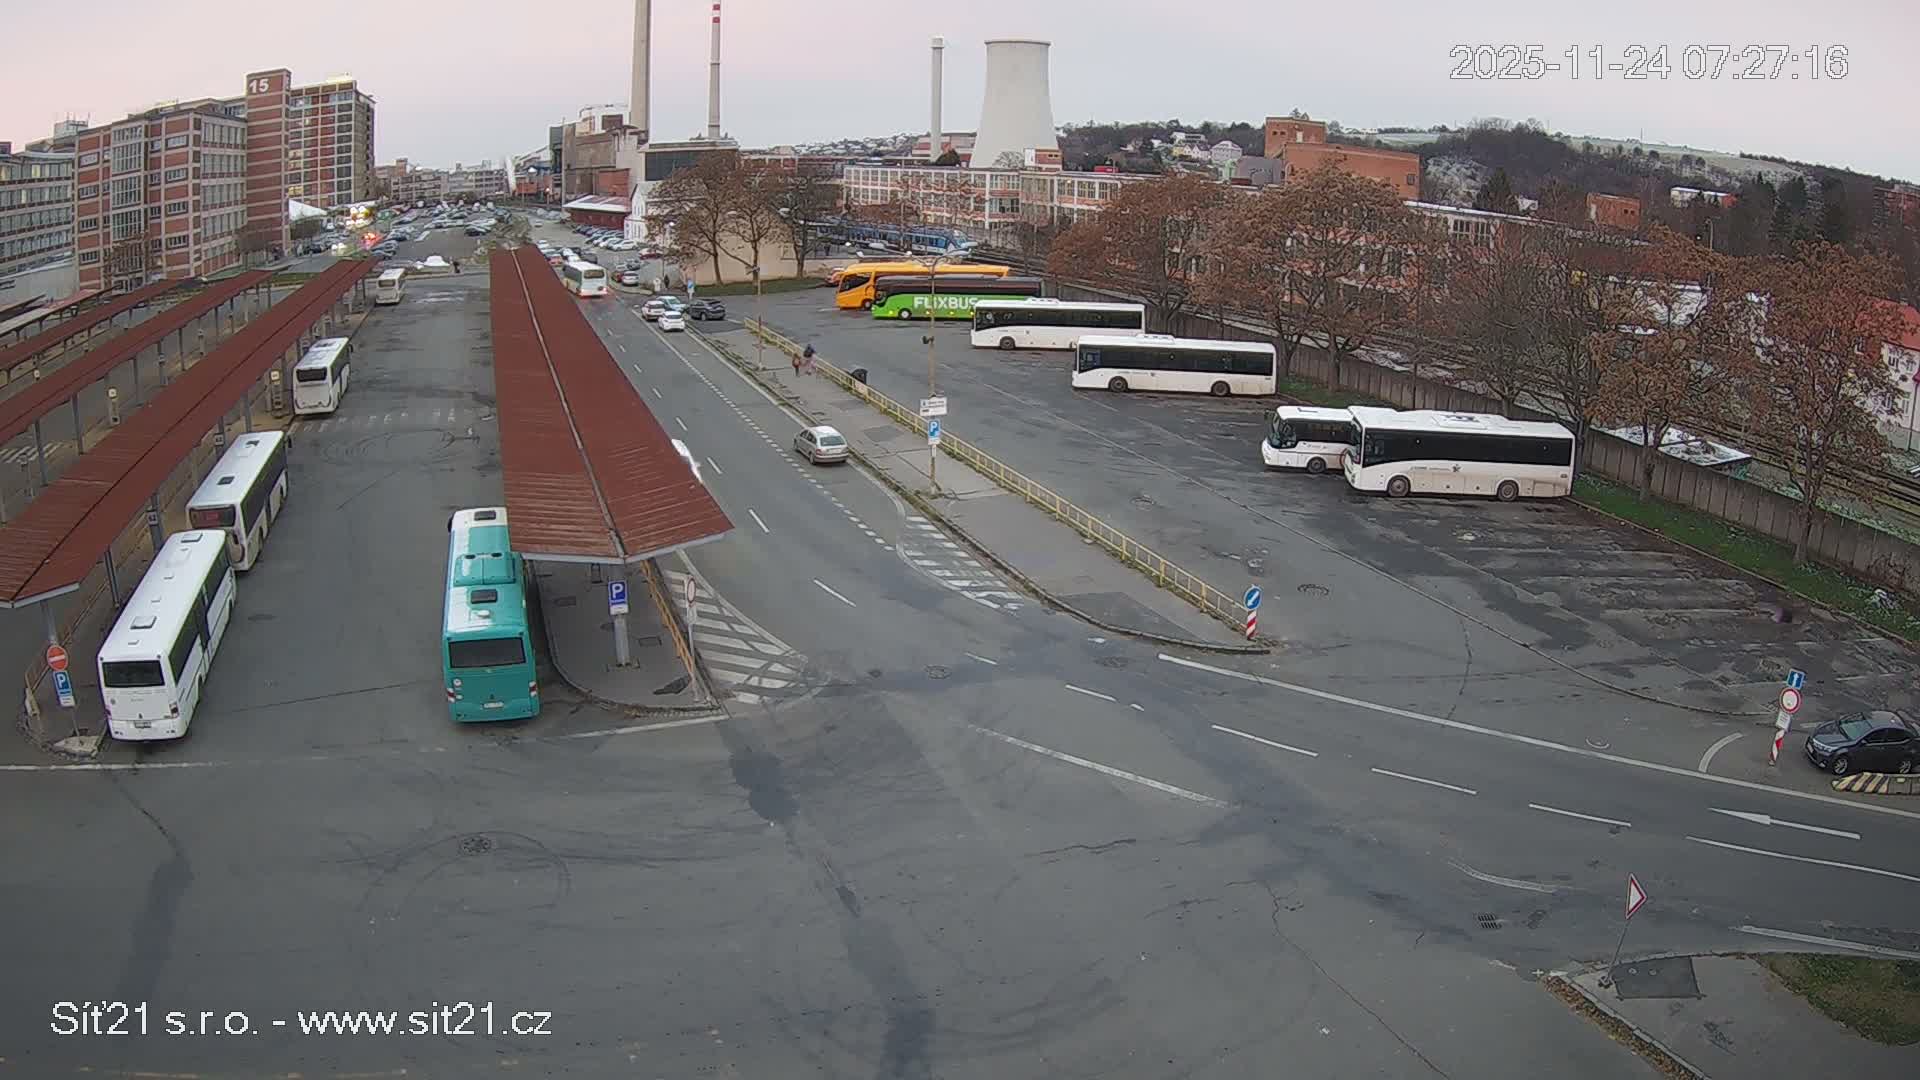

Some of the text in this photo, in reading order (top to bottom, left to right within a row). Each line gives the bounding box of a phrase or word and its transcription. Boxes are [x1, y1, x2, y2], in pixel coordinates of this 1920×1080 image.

[249, 79, 269, 93] 15
[612, 583, 624, 599] P
[57, 674, 66, 688] P
